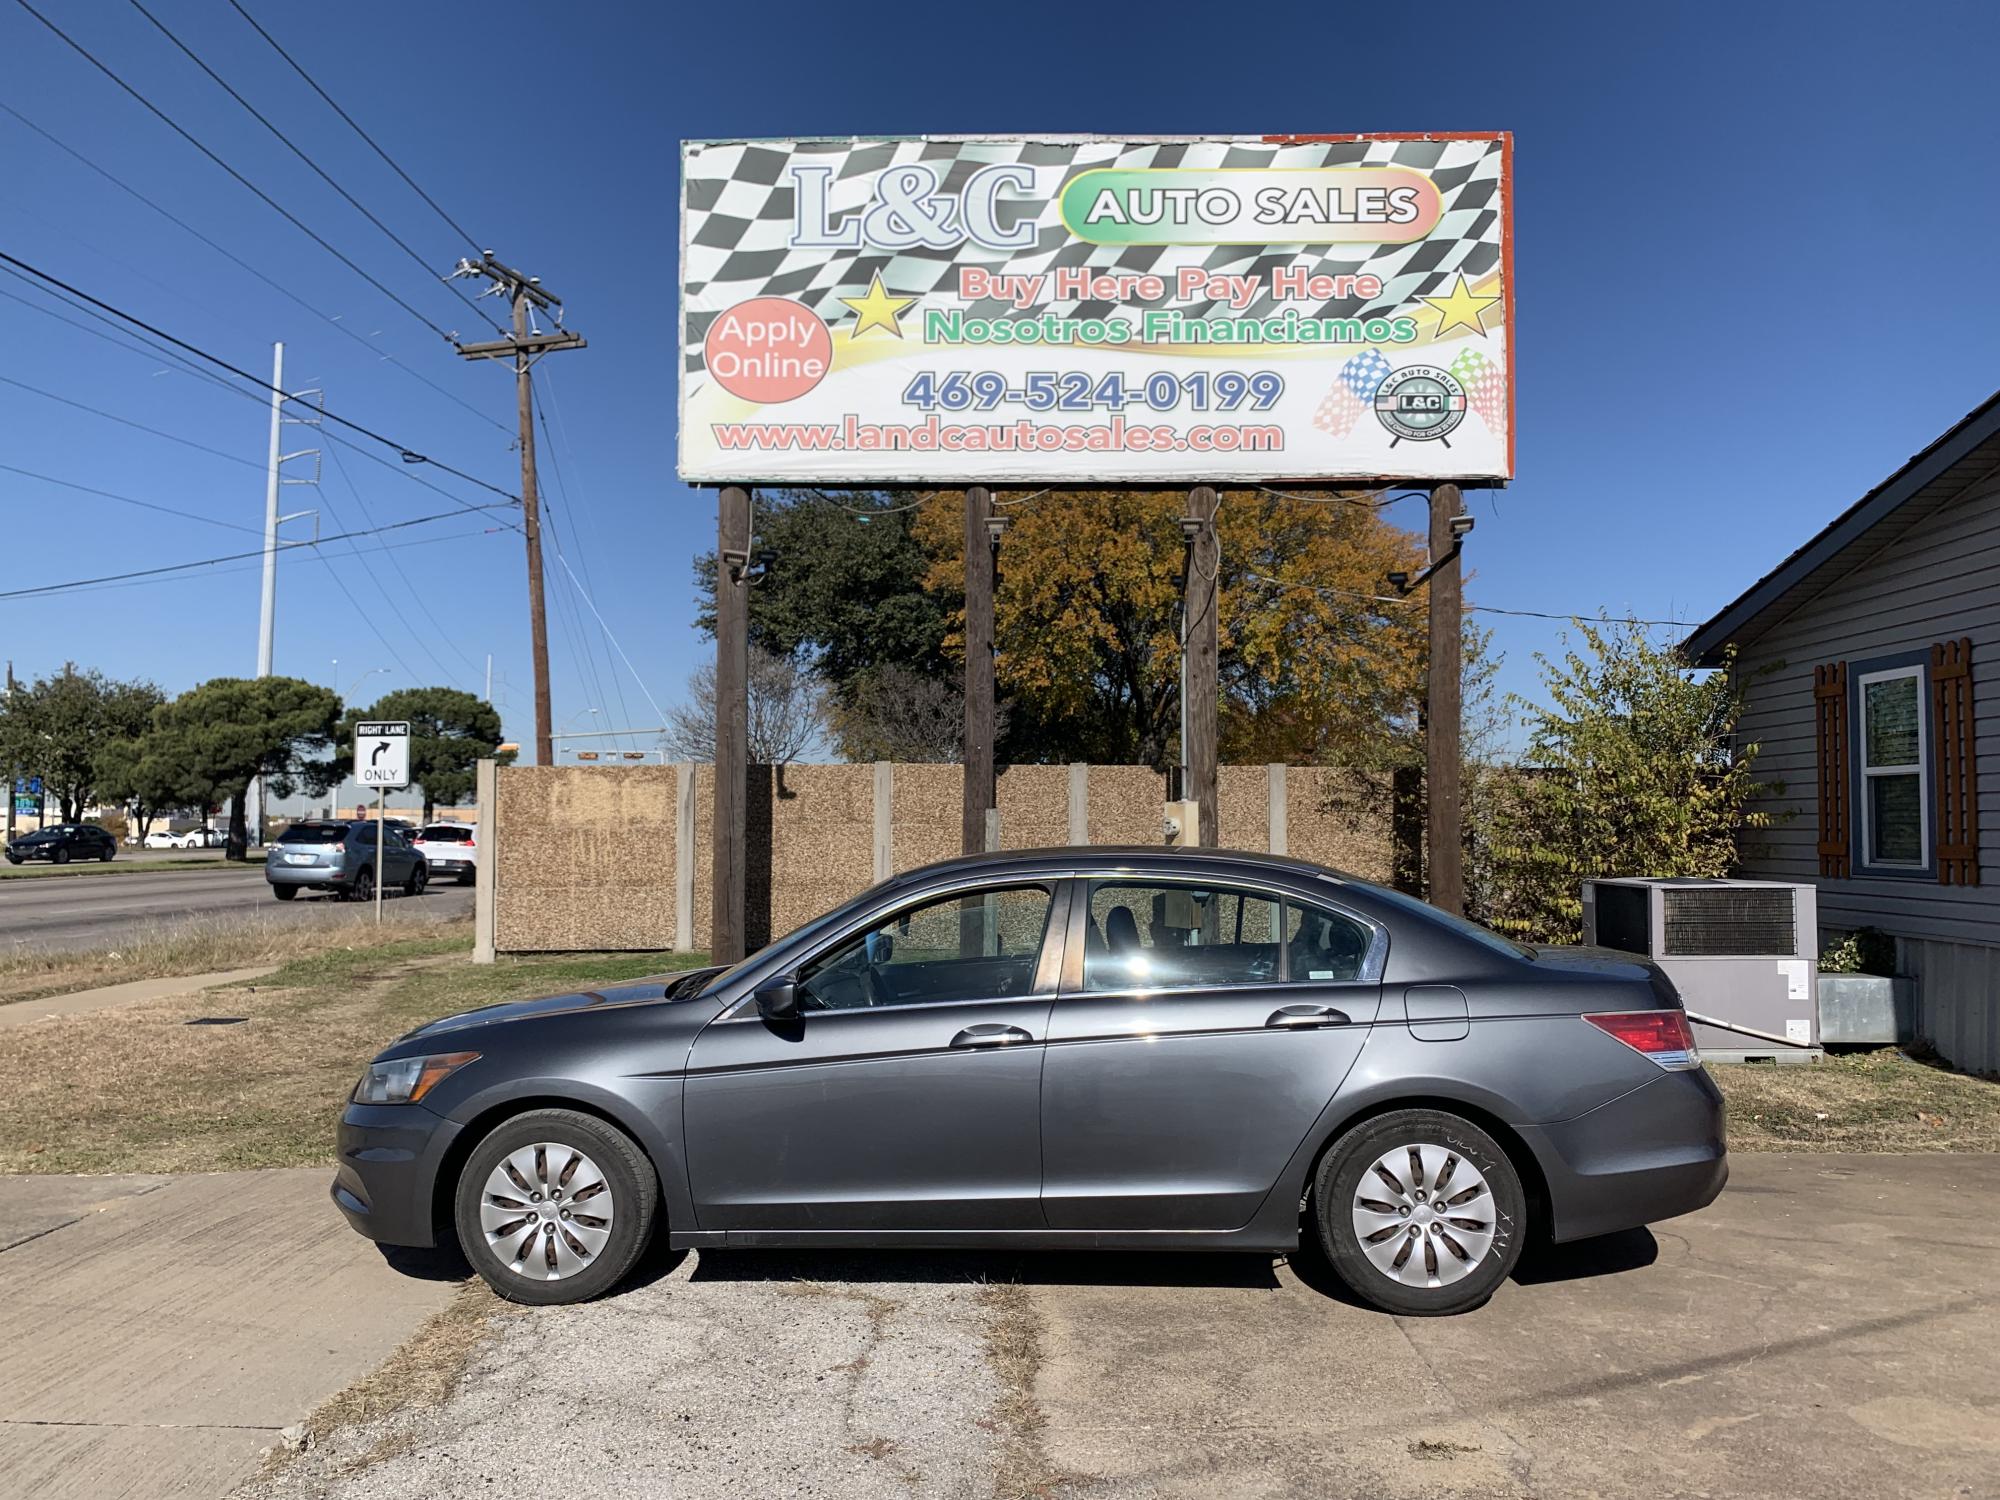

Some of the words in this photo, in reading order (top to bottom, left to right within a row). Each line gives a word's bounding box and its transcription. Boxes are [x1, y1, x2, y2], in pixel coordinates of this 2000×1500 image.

[789, 164, 1037, 249] L&C
[1084, 188, 1241, 225] AUTO
[1254, 187, 1419, 225] SALES
[959, 267, 1046, 308] Buy
[1057, 266, 1165, 301] Here
[1177, 266, 1261, 310] Pay
[1272, 266, 1384, 301] Here
[718, 315, 817, 347] Apply
[924, 308, 1132, 345] Nosotros
[1142, 309, 1418, 345] Financiamos
[712, 352, 824, 379] Online
[1401, 369, 1430, 379] AUTO
[1434, 372, 1458, 394] SALES
[902, 371, 1284, 411] 469-524-0199
[1401, 396, 1440, 410] L&C
[711, 415, 1284, 452] www.landcautosales.com
[358, 725, 382, 735] RIGHT
[385, 725, 406, 735] LANE
[364, 769, 398, 781] ONLY
